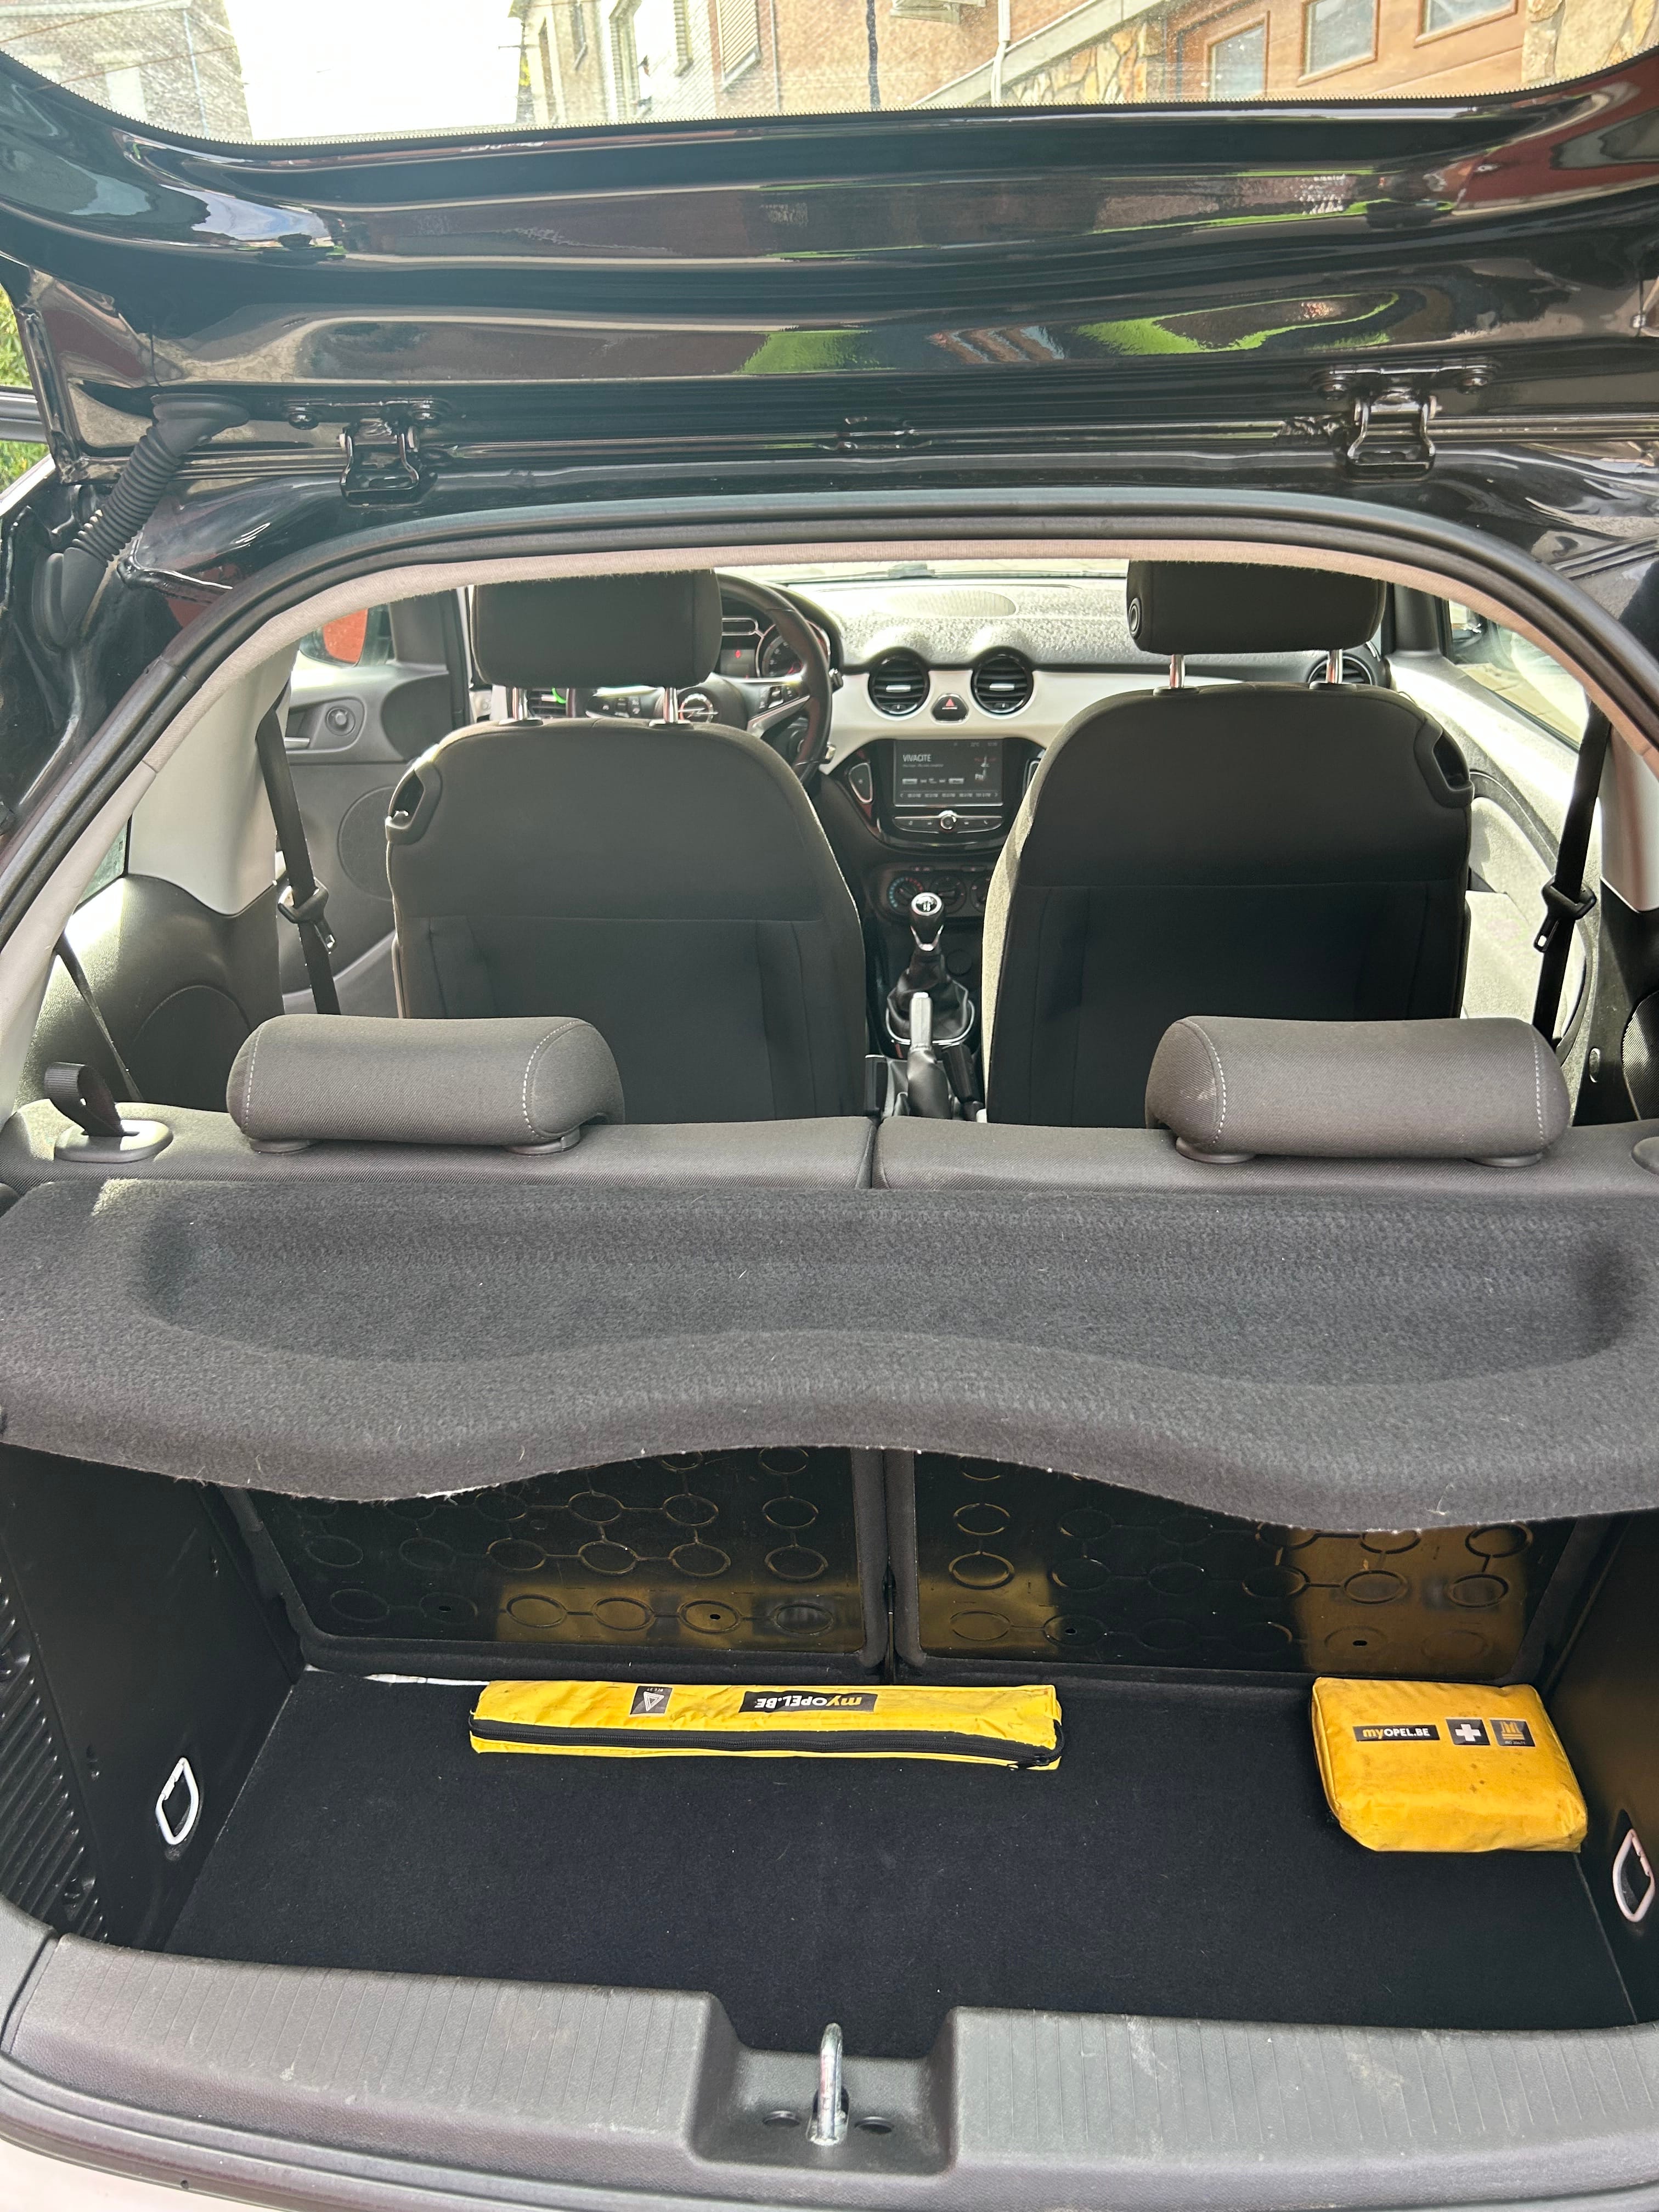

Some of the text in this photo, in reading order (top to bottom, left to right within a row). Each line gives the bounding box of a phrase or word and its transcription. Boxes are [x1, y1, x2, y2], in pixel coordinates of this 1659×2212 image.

[902, 754, 932, 762] VIVACITE
[754, 1695, 862, 1708] myOPEL.BE
[1363, 1728, 1430, 1739] myOPEL.BE
